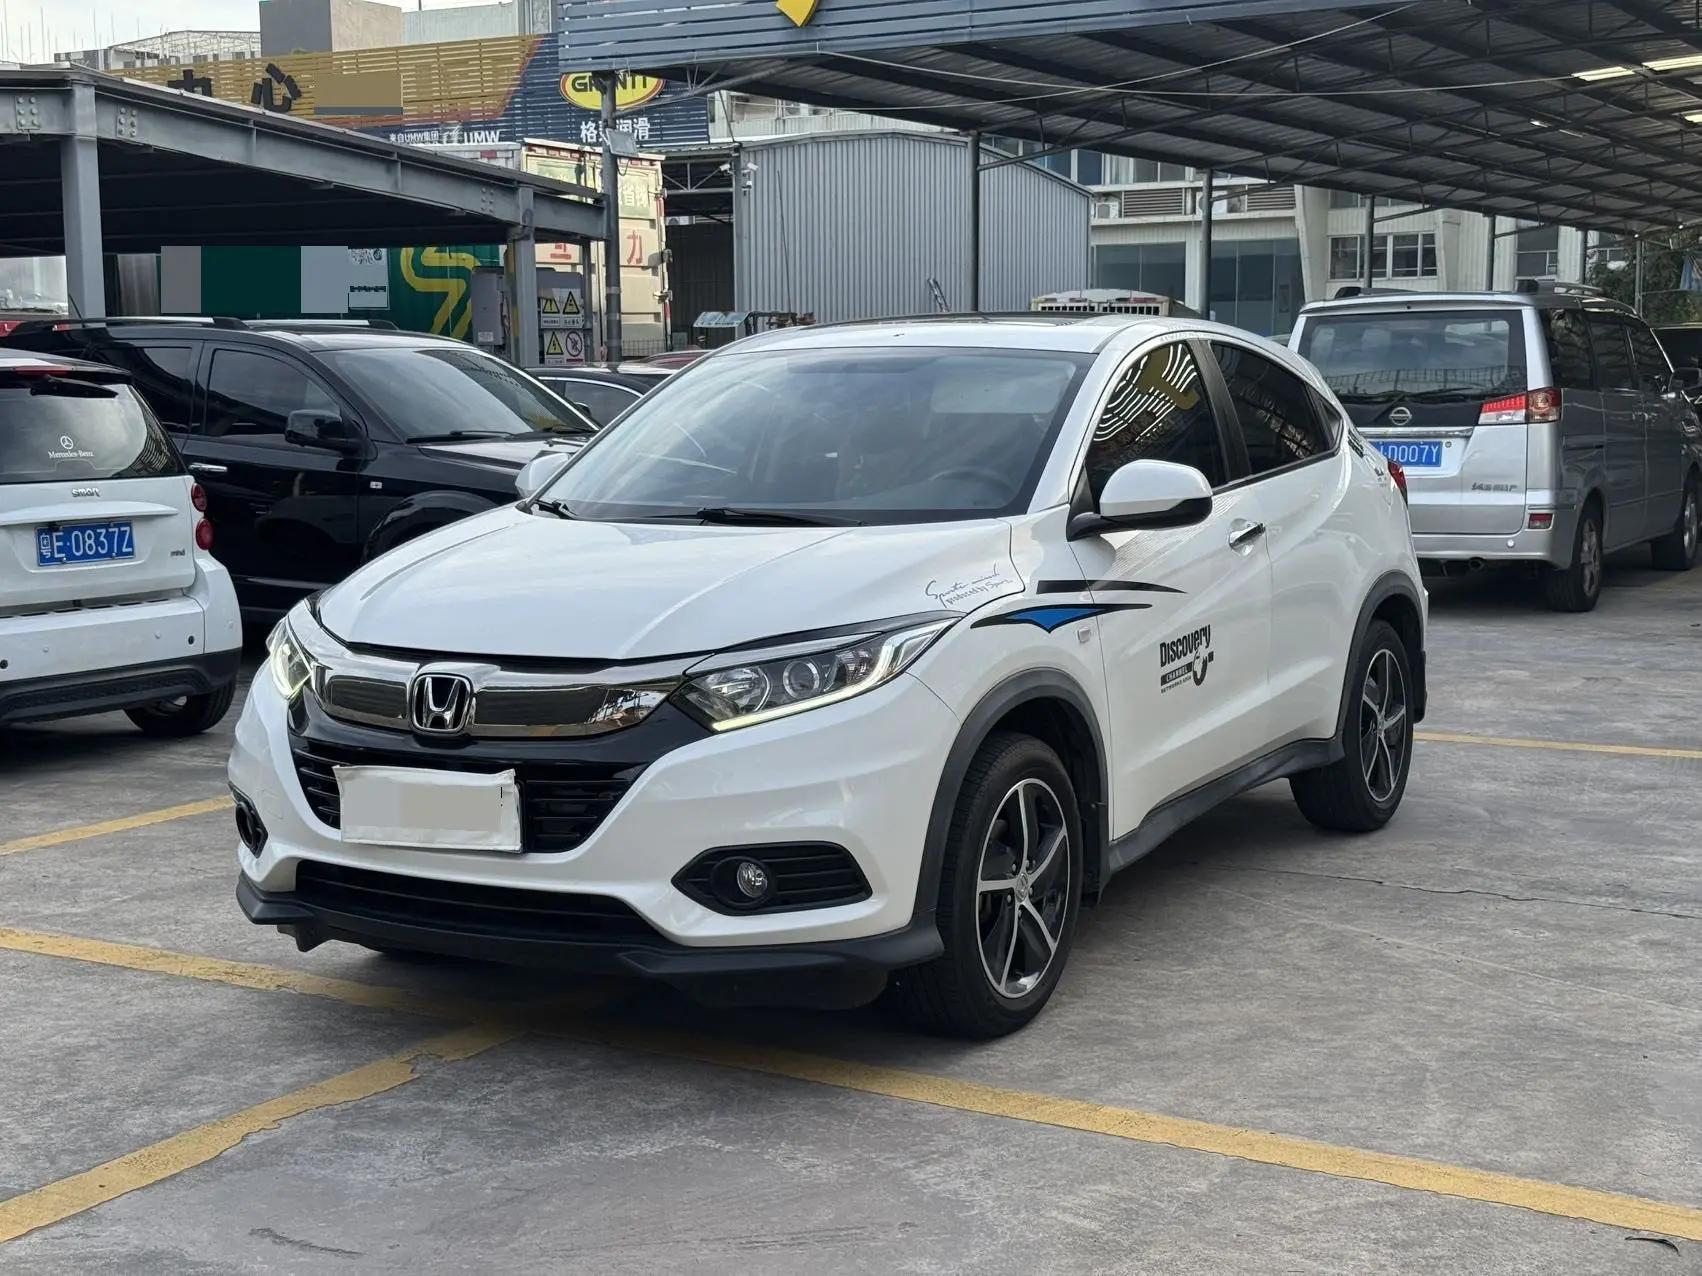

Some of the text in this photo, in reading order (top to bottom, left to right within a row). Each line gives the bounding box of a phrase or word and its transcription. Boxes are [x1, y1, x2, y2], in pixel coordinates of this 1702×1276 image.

[580, 117, 651, 144] 格润滑
[463, 130, 500, 144] UMW
[48, 449, 94, 459] Mercedes-Benz
[72, 488, 100, 497] smart
